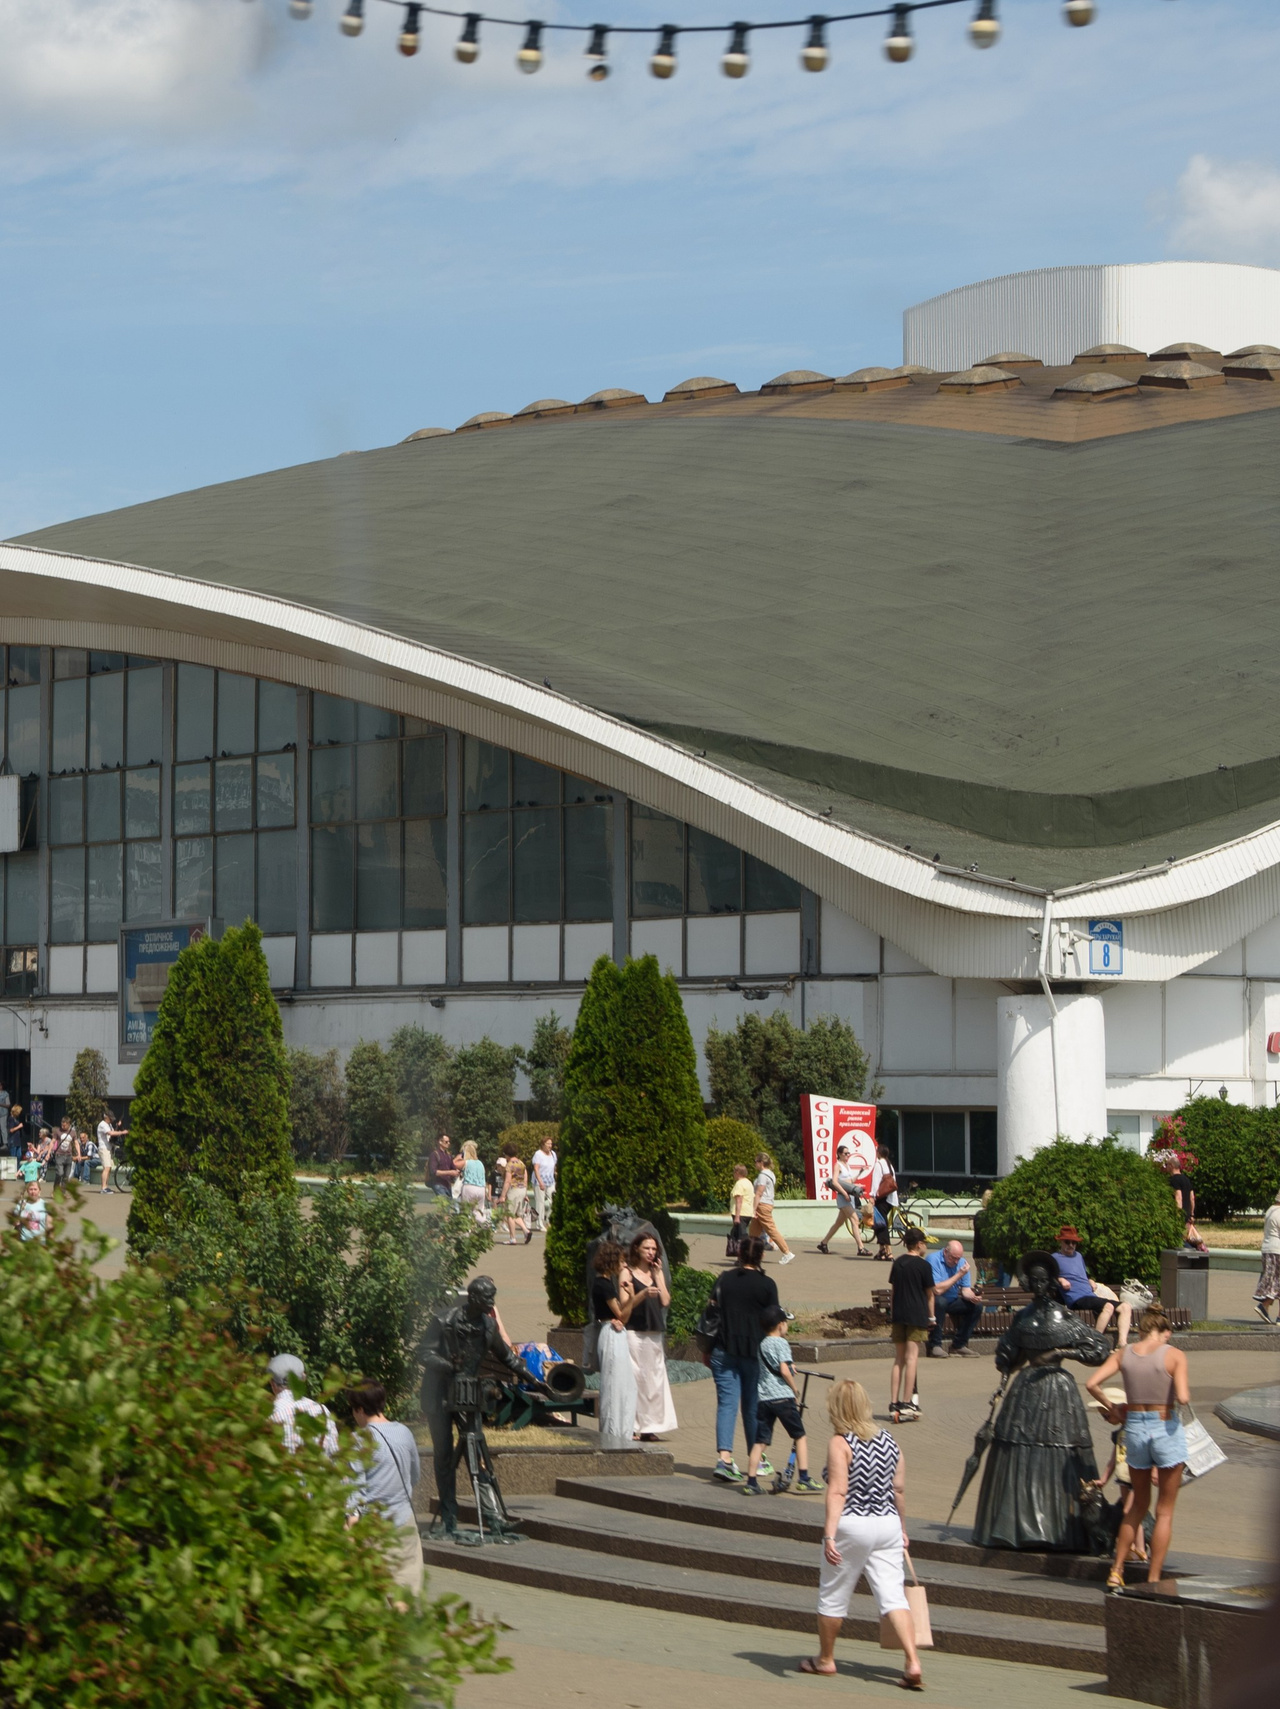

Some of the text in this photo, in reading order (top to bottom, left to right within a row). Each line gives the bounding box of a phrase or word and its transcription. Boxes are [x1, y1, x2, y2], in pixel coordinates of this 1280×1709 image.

[144, 932, 174, 943] ОТЛИЧНОЕ
[139, 941, 180, 954] ПРЕДЛОЖЕНИЕ!
[1103, 944, 1110, 967] 8
